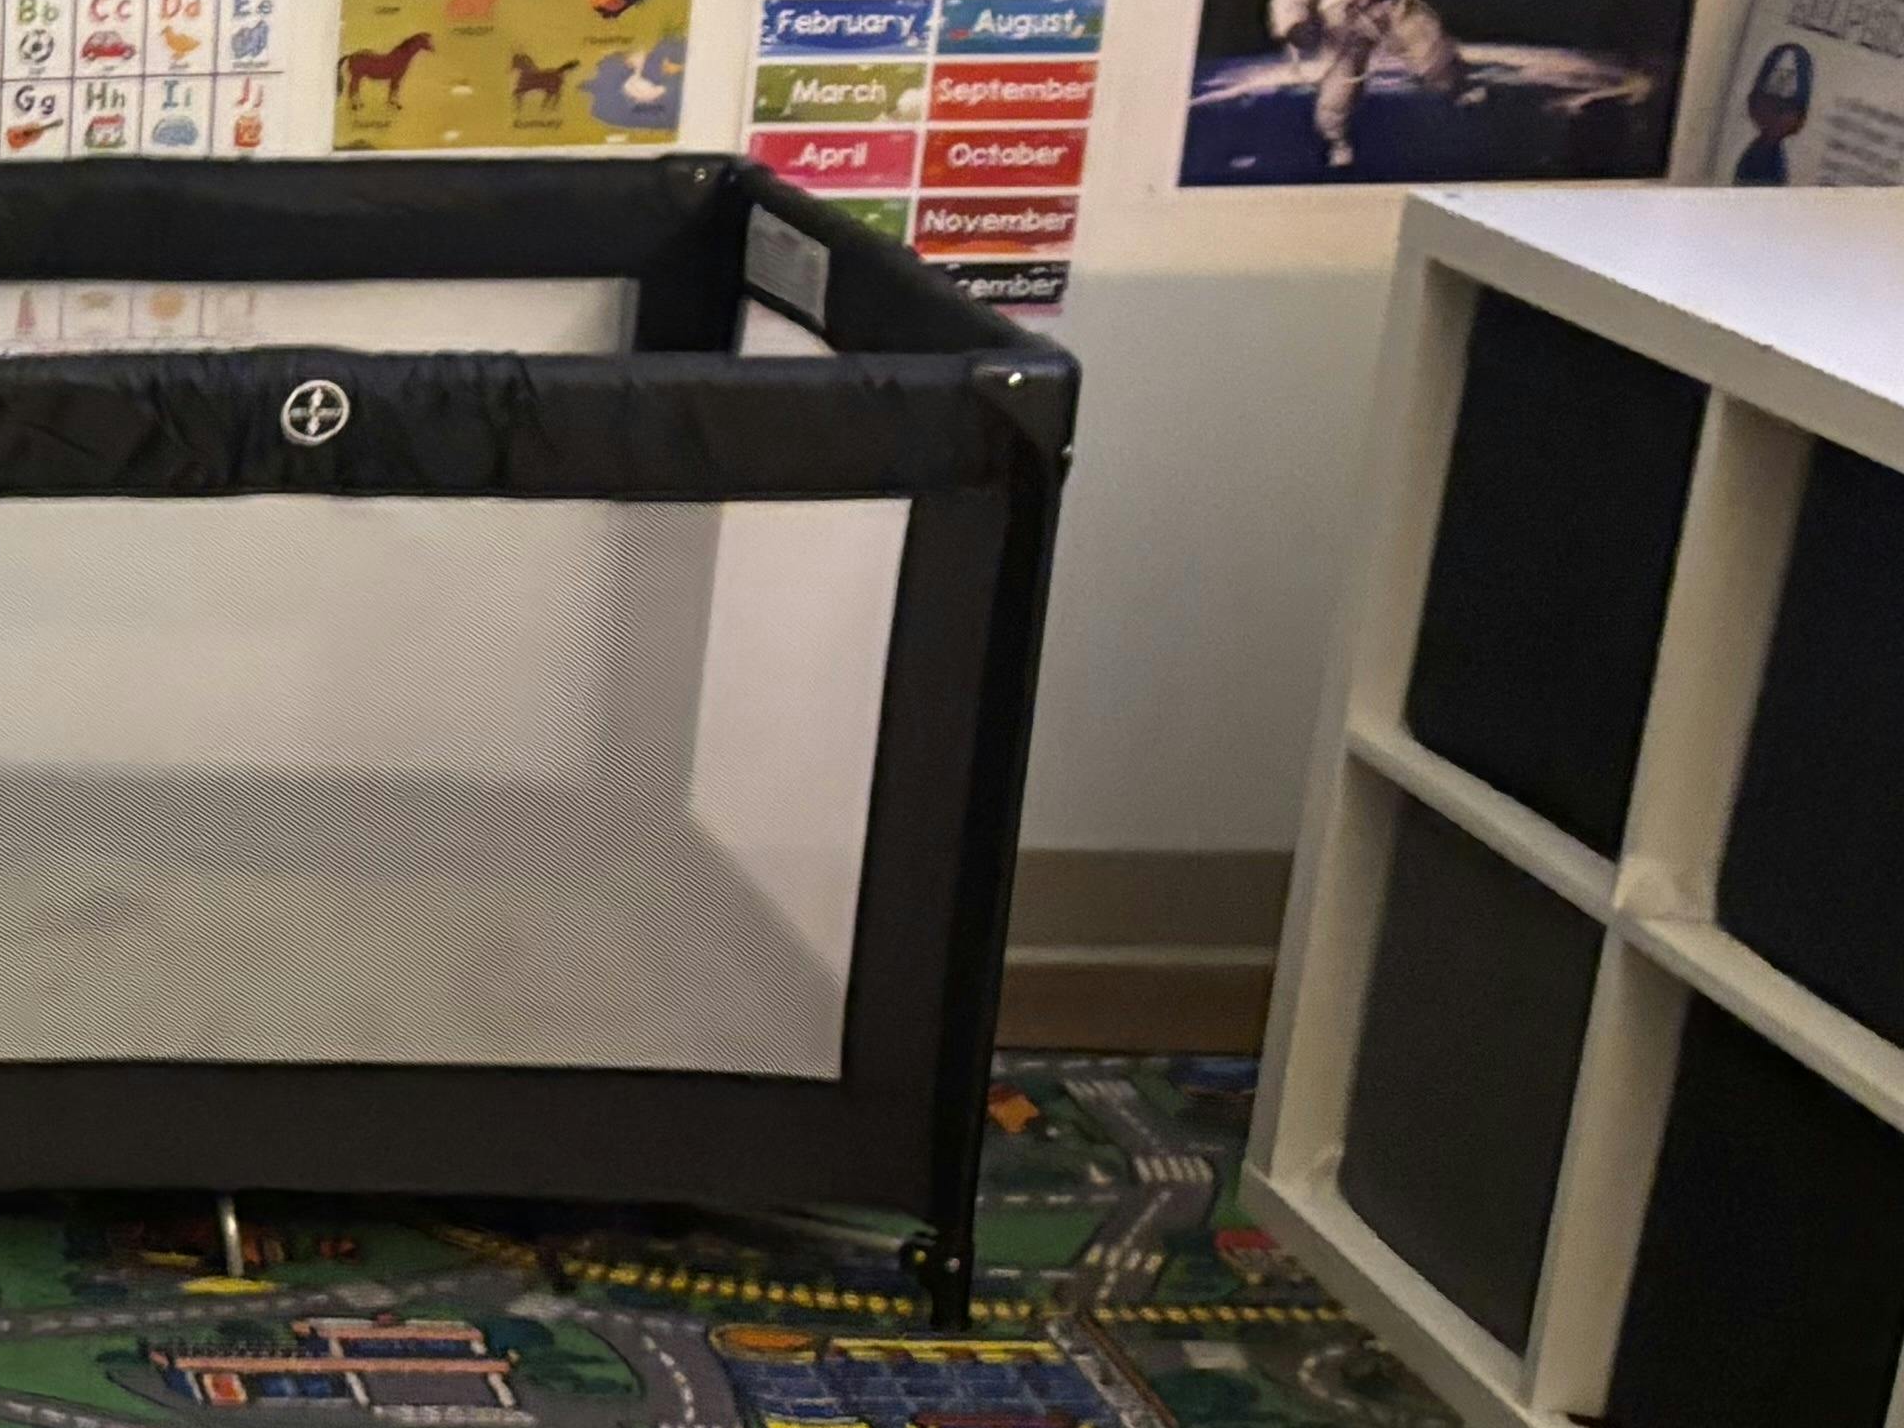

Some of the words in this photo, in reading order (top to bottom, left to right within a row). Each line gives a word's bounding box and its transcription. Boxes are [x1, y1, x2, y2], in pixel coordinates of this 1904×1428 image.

[776, 10, 916, 38] February
[973, 9, 1076, 40] August
[15, 85, 56, 115] Gg
[792, 79, 887, 105] March
[937, 77, 1092, 107] September
[794, 142, 869, 171] April
[947, 143, 1069, 167] October
[922, 209, 1075, 233] November
